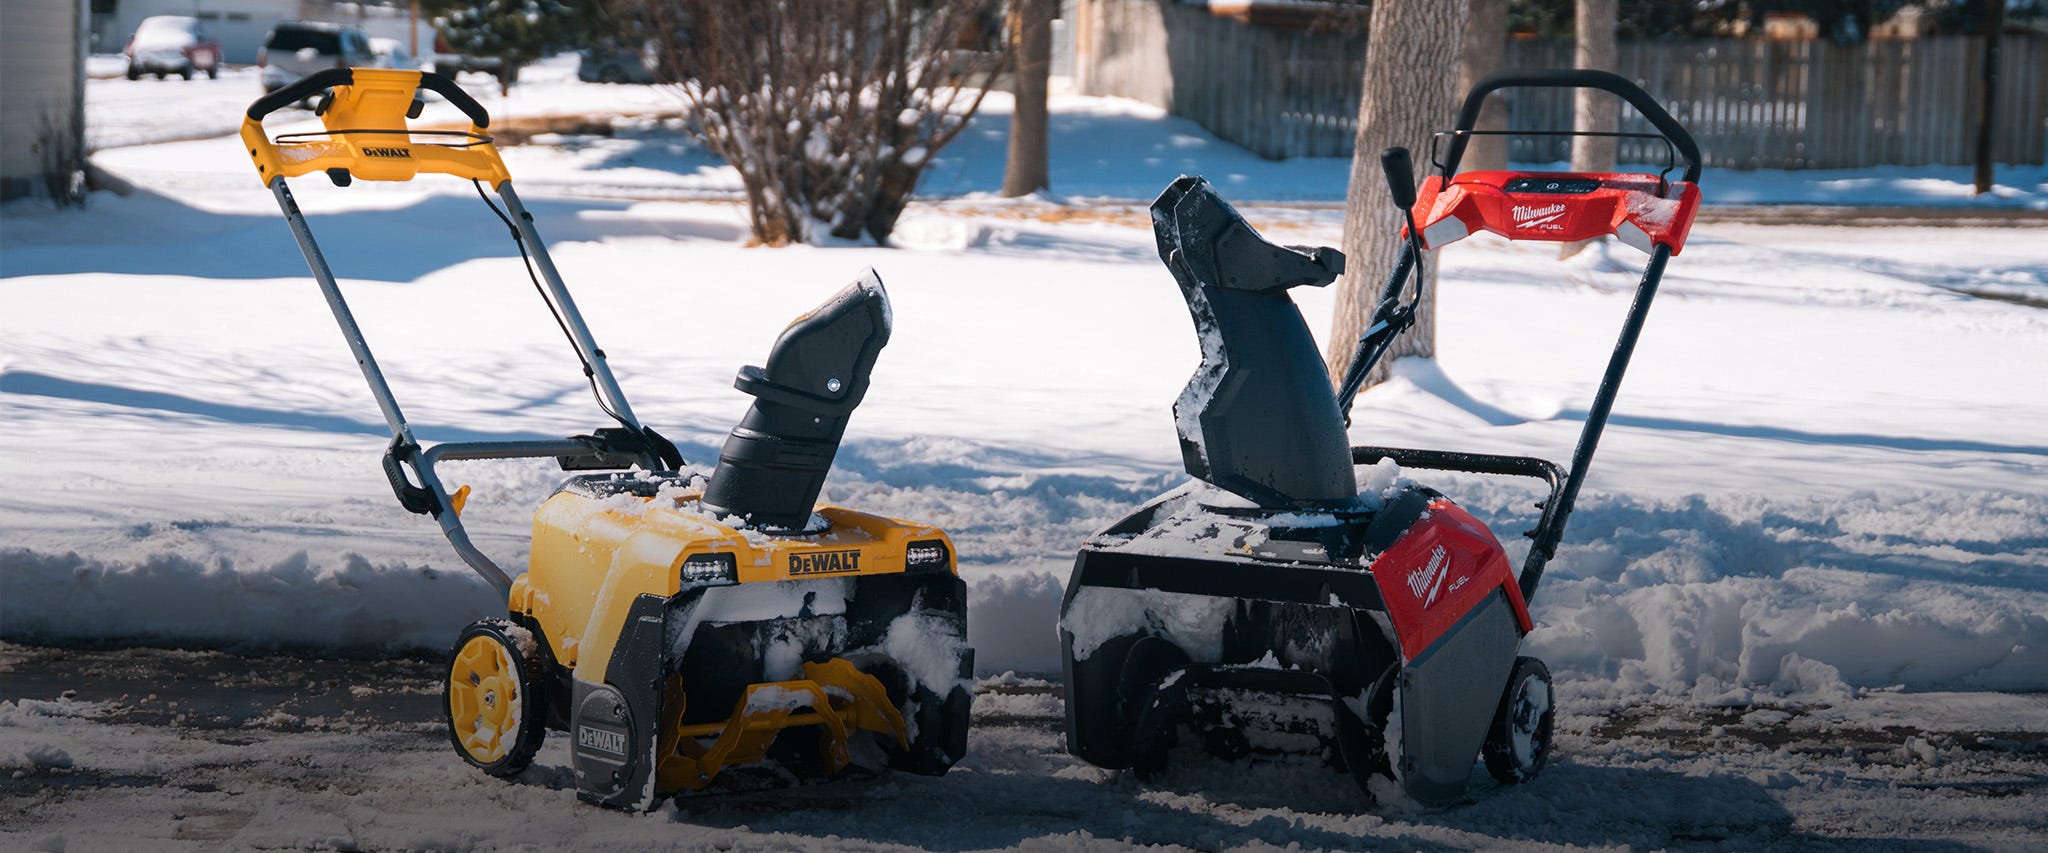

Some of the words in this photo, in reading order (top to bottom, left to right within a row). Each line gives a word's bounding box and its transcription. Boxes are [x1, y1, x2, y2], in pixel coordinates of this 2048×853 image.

[1512, 203, 1566, 222] Milwaukee
[789, 551, 861, 573] DEWALT
[1407, 544, 1447, 599] Milwaukee
[1448, 575, 1470, 593] FUEL
[580, 726, 625, 753] DEWALT
